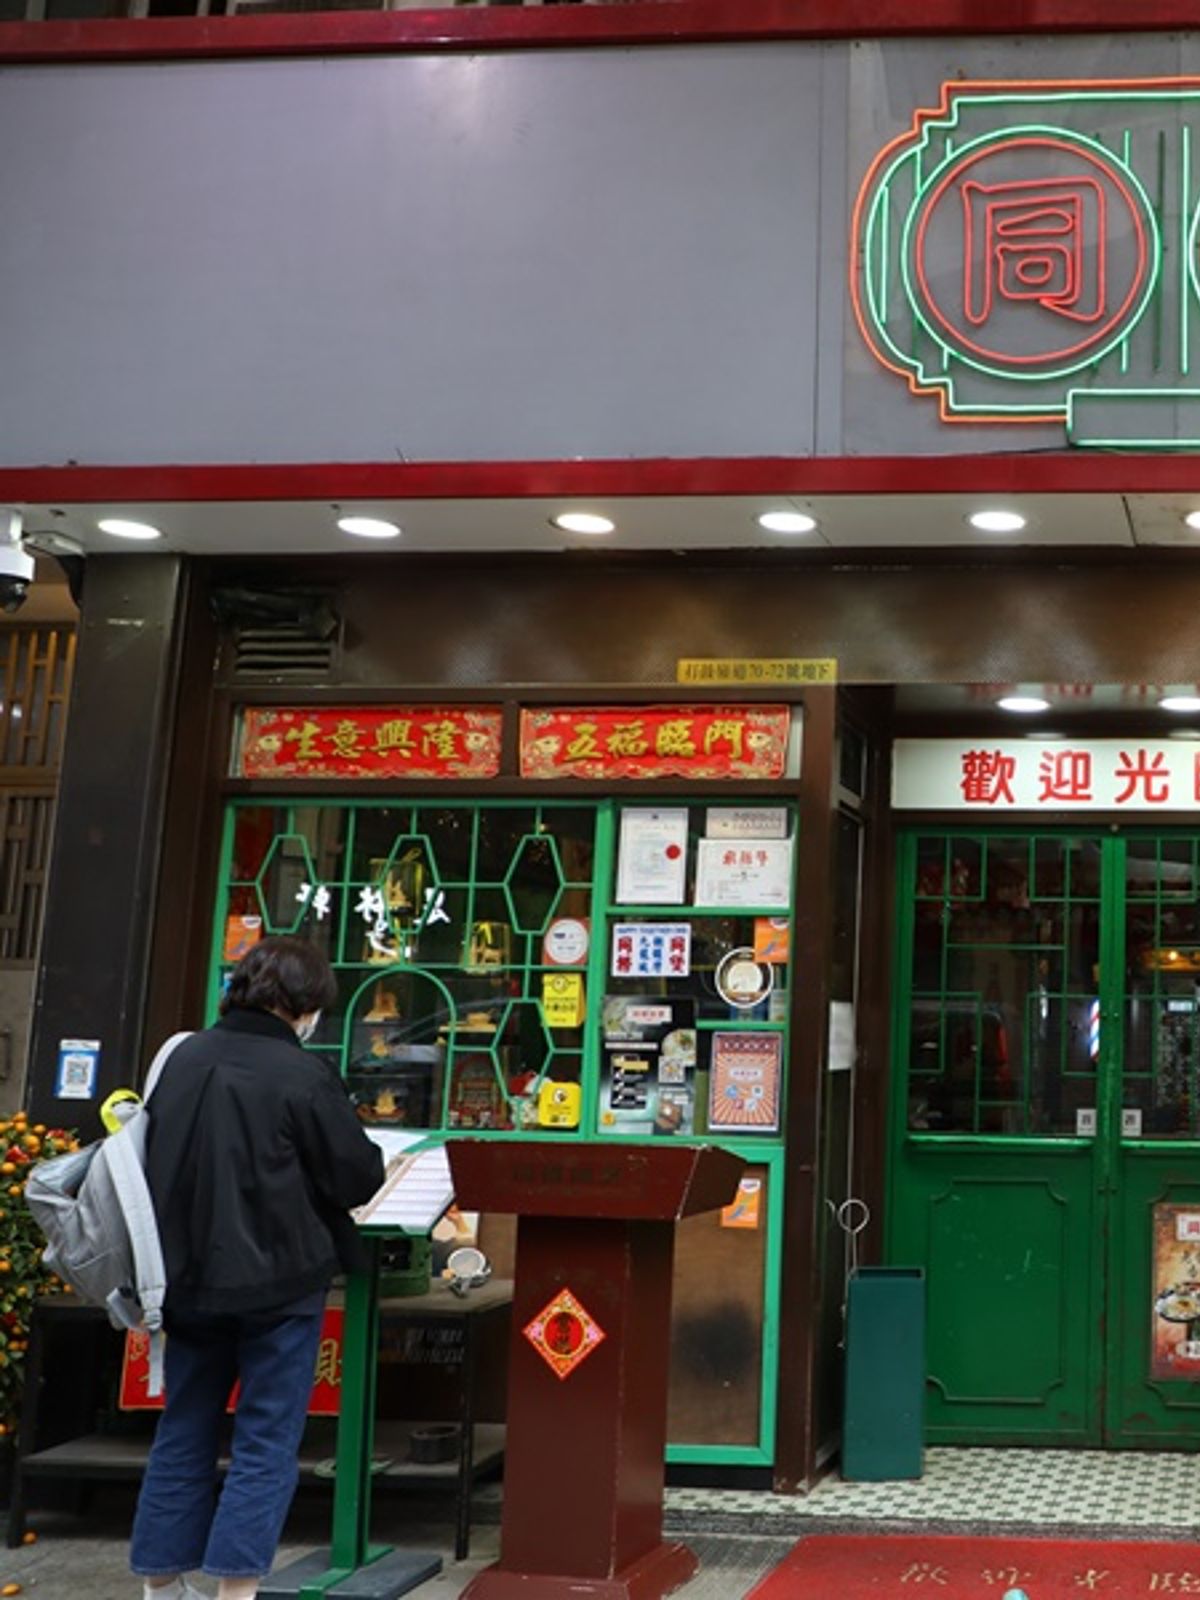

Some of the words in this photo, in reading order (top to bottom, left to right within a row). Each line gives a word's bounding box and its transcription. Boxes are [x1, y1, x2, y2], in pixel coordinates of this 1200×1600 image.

[285, 718, 465, 761] 生意興隆
[564, 718, 745, 763] 五福臨門
